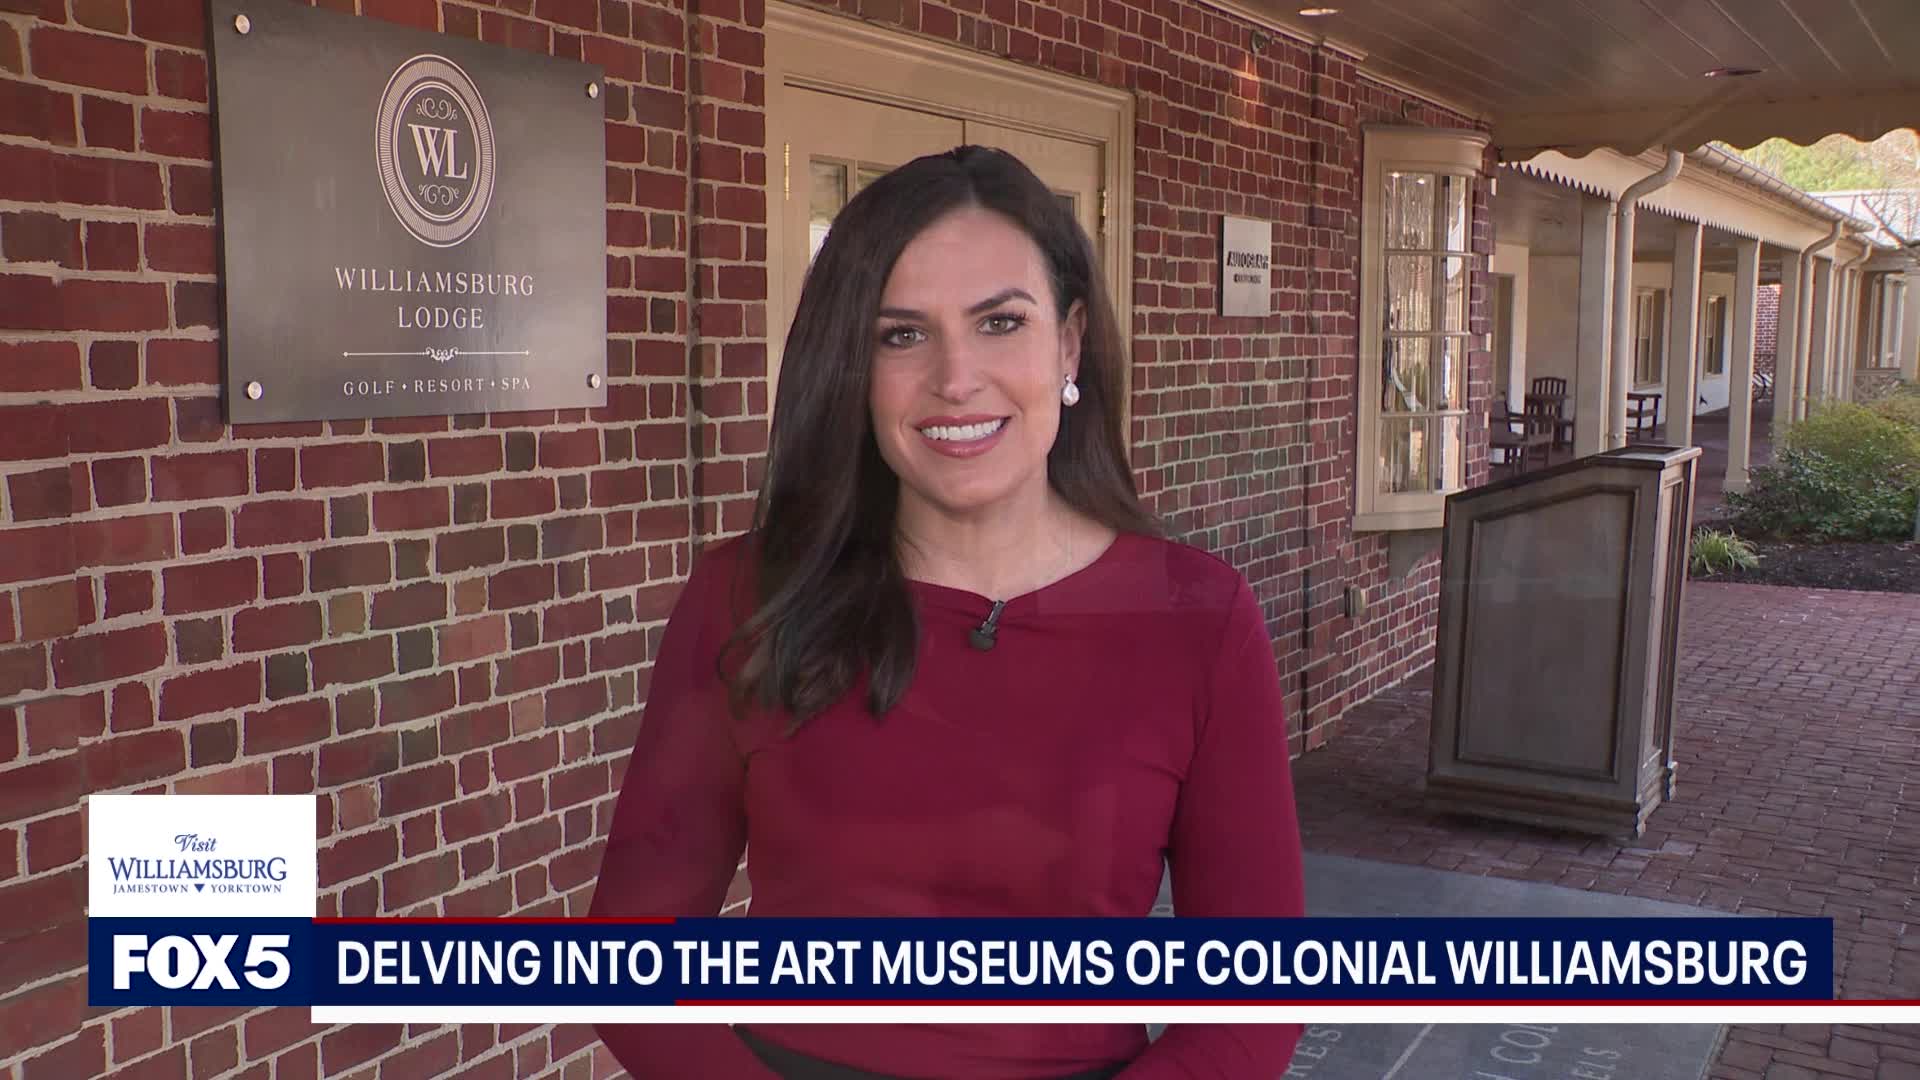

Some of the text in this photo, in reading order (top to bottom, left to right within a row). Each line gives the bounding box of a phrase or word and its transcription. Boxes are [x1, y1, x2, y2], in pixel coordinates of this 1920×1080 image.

[407, 123, 468, 181] WL
[335, 267, 535, 297] WILLIAMSBURG
[398, 306, 485, 329] LODGE
[343, 377, 532, 396] GOLF RESORT SPA
